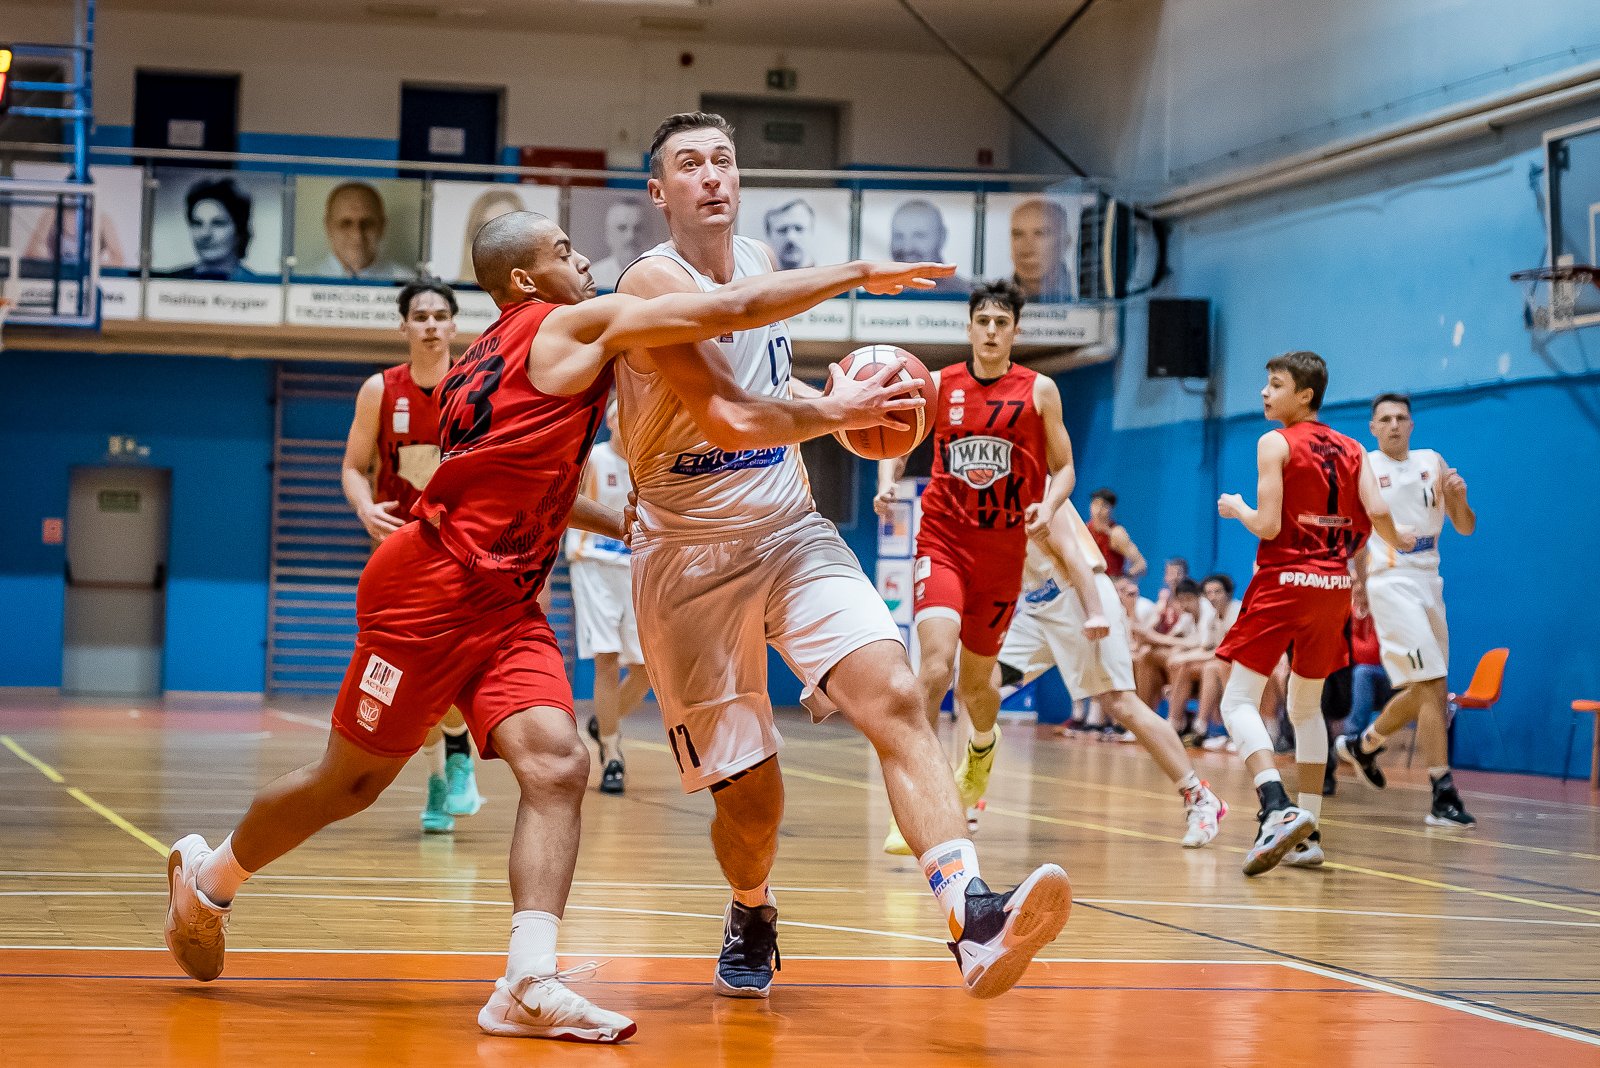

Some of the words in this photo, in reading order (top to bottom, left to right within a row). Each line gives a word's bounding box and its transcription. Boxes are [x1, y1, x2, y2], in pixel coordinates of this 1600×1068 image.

[159, 293, 207, 306] Halina
[985, 400, 1025, 429] 77
[958, 442, 1003, 463] WKK
[365, 679, 391, 697] ACTIVE
[668, 723, 701, 775] 17
[934, 869, 965, 898] UDETY
